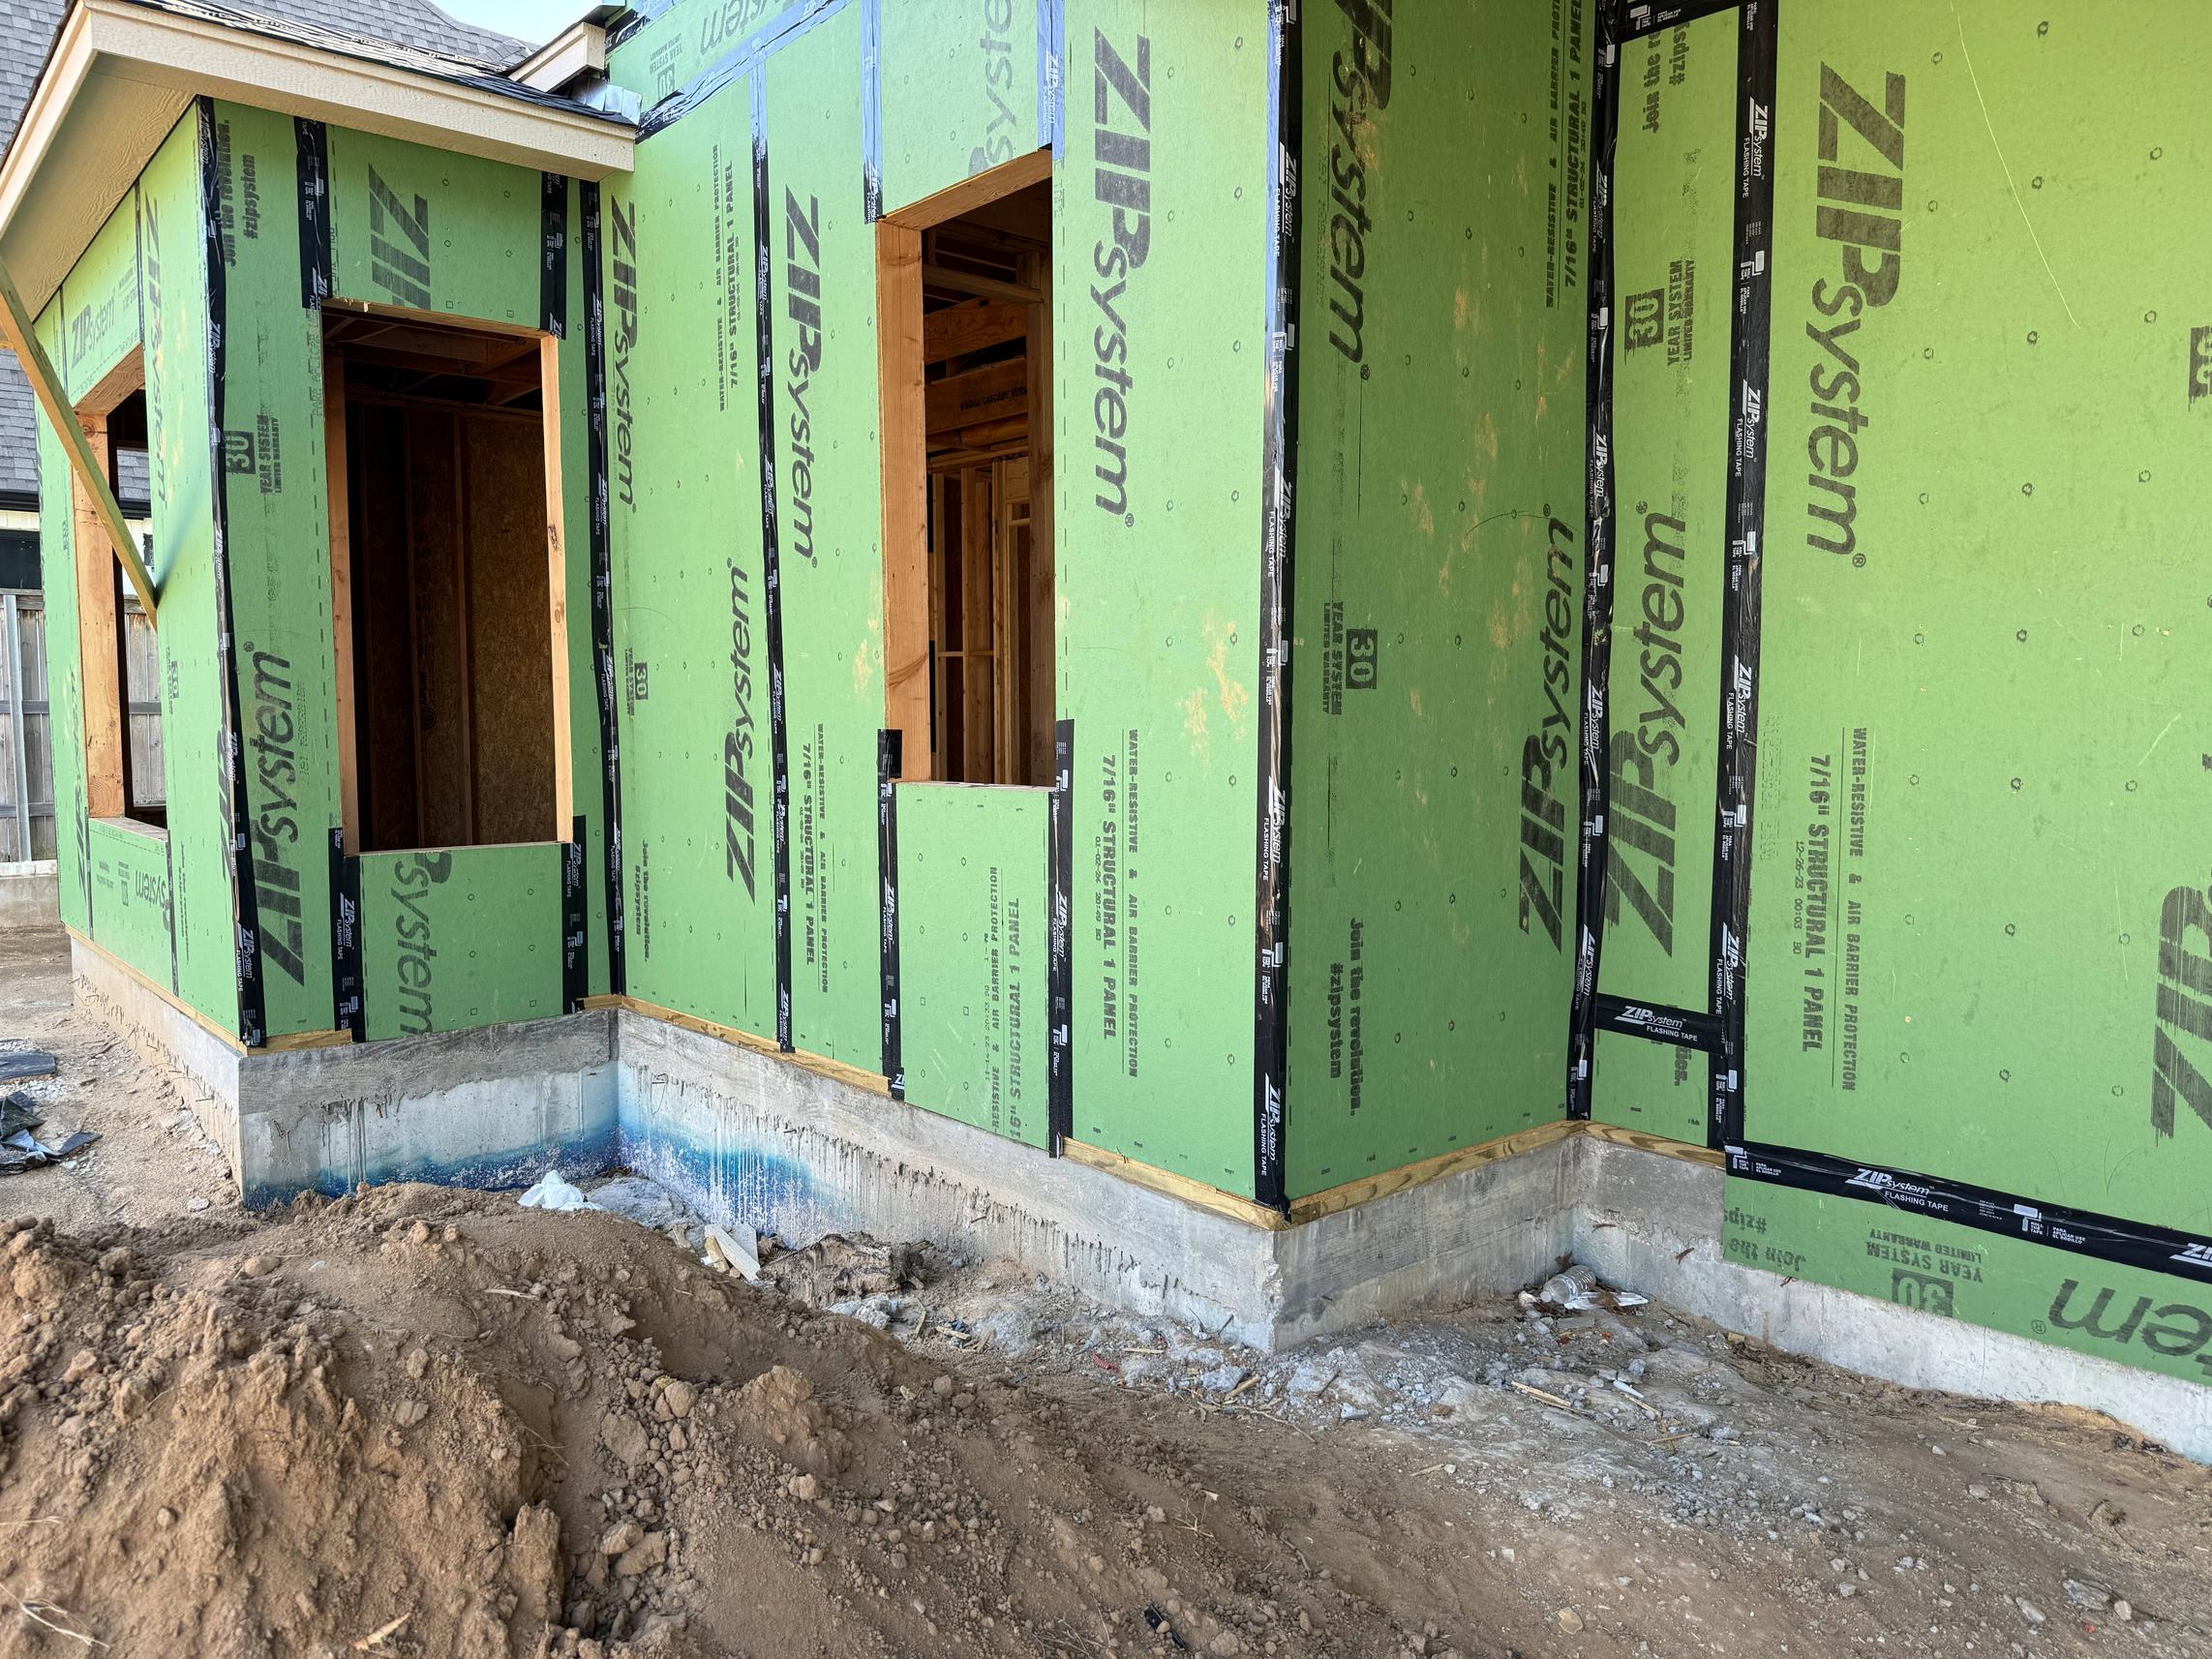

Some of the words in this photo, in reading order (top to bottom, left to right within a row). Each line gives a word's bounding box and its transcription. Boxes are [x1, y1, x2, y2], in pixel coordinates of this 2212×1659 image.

[1549, 46, 1560, 109] BARRIER
[1643, 53, 1660, 86] the
[1549, 117, 1559, 142] AIR
[1643, 95, 1660, 135] Join
[1566, 92, 1581, 223] STRUCTURAL
[724, 160, 734, 215] PANEL
[726, 232, 738, 336] STRUCTURAL
[1669, 260, 1682, 320] SYSTEM
[1667, 326, 1682, 367] YEAR
[1267, 511, 1276, 555] FLASHING
[1266, 556, 1275, 578] TAPE
[1331, 601, 1344, 645] YEAR
[1331, 649, 1344, 716] SYSTEM
[1348, 634, 1377, 687] 30
[1128, 728, 1138, 854] WATER-RESISTIVE
[1849, 727, 1867, 858] WATER-RESISTIVE
[804, 795, 815, 895] STRUCTURAL
[988, 866, 999, 941] PROTECTION
[1103, 820, 1116, 950] STRUCTURAL
[1128, 892, 1138, 919] AIR
[1804, 823, 1830, 959] STRUCTURAL
[1847, 899, 1862, 925] AIR
[805, 916, 815, 966] PANEL
[1008, 897, 1019, 958] PANEL
[1349, 917, 1364, 961] Join
[821, 927, 830, 993] PROTECTION
[1103, 957, 1116, 969] 1
[1128, 926, 1138, 986] BARRIER
[1348, 964, 1364, 1001] the
[1804, 967, 1825, 979] 1
[1844, 932, 1861, 997] BARRIER
[1103, 975, 1116, 1041] PANEL
[1128, 993, 1138, 1077] PROTECTION
[1327, 962, 1344, 1078] #zipsystem
[1646, 1025, 1681, 1039] FLASHING
[1681, 1031, 1699, 1042] TAPE
[1802, 985, 1825, 1053] PANEL
[1009, 981, 1020, 1101] STRUCTURAL
[1842, 1003, 1860, 1091] PROTECTION
[1884, 1190, 1925, 1207] FLASHING
[1926, 1200, 1950, 1213] TAPE
[1727, 1237, 1759, 1261] the
[1767, 1246, 1807, 1273] Join
[1864, 1241, 1933, 1272] SYSTEM
[1939, 1258, 1984, 1283] YEAR
